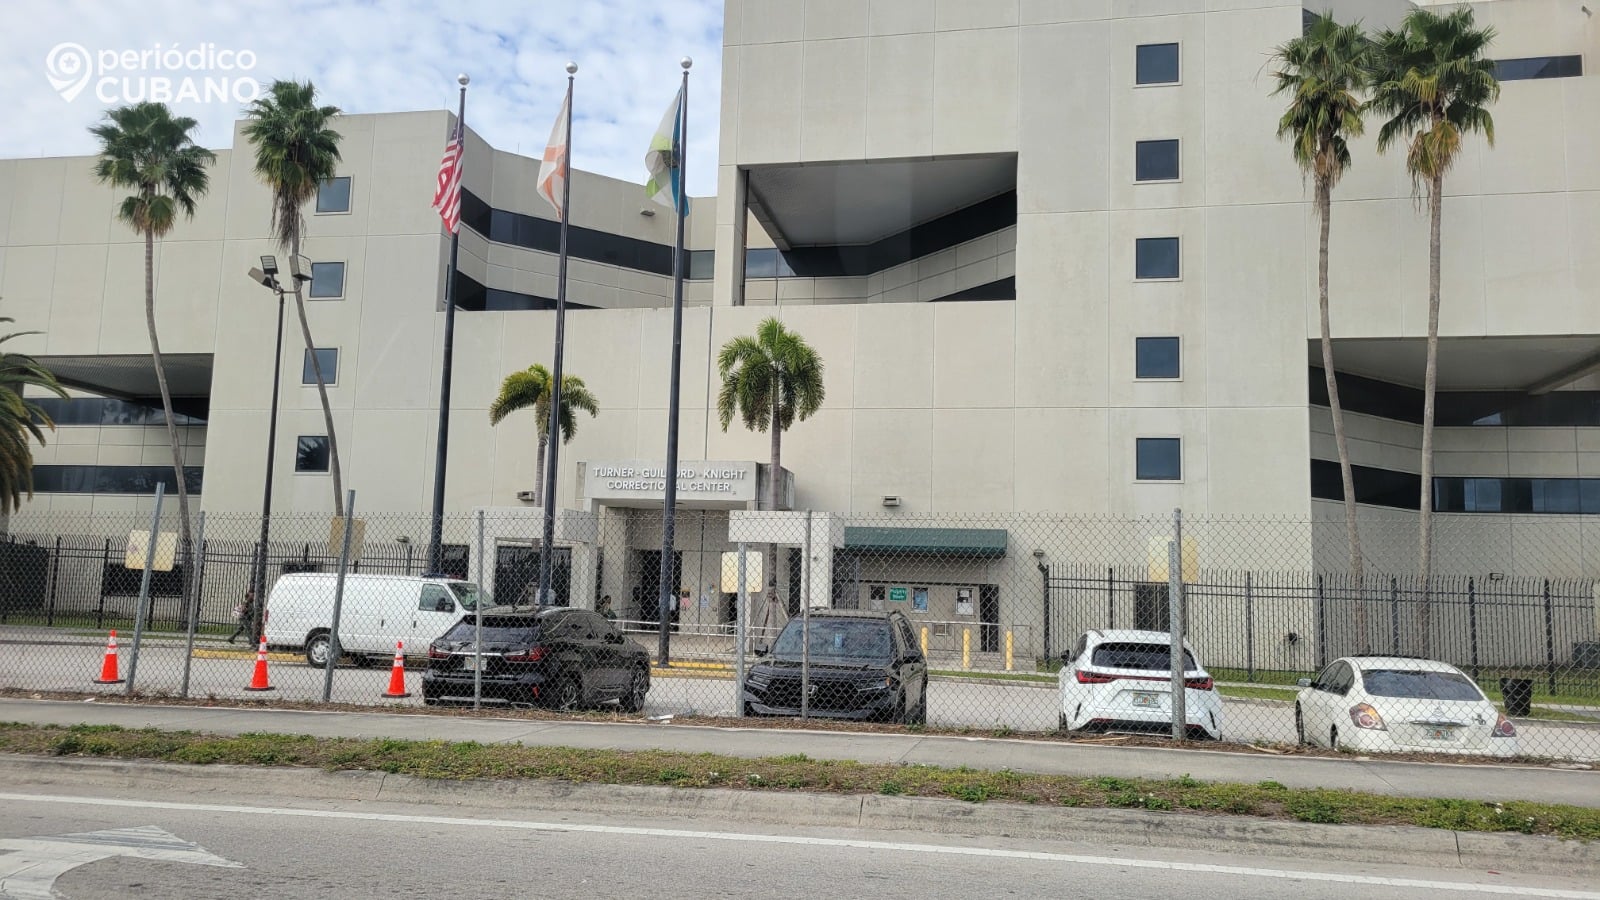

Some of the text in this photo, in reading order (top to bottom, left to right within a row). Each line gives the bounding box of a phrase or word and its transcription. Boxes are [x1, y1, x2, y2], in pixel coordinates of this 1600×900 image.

[593, 467, 634, 477] TURNER
[642, 468, 695, 478] GUILRD
[703, 469, 745, 479] KNIGHT
[607, 480, 730, 491] CORRECTIOAL CENTER
